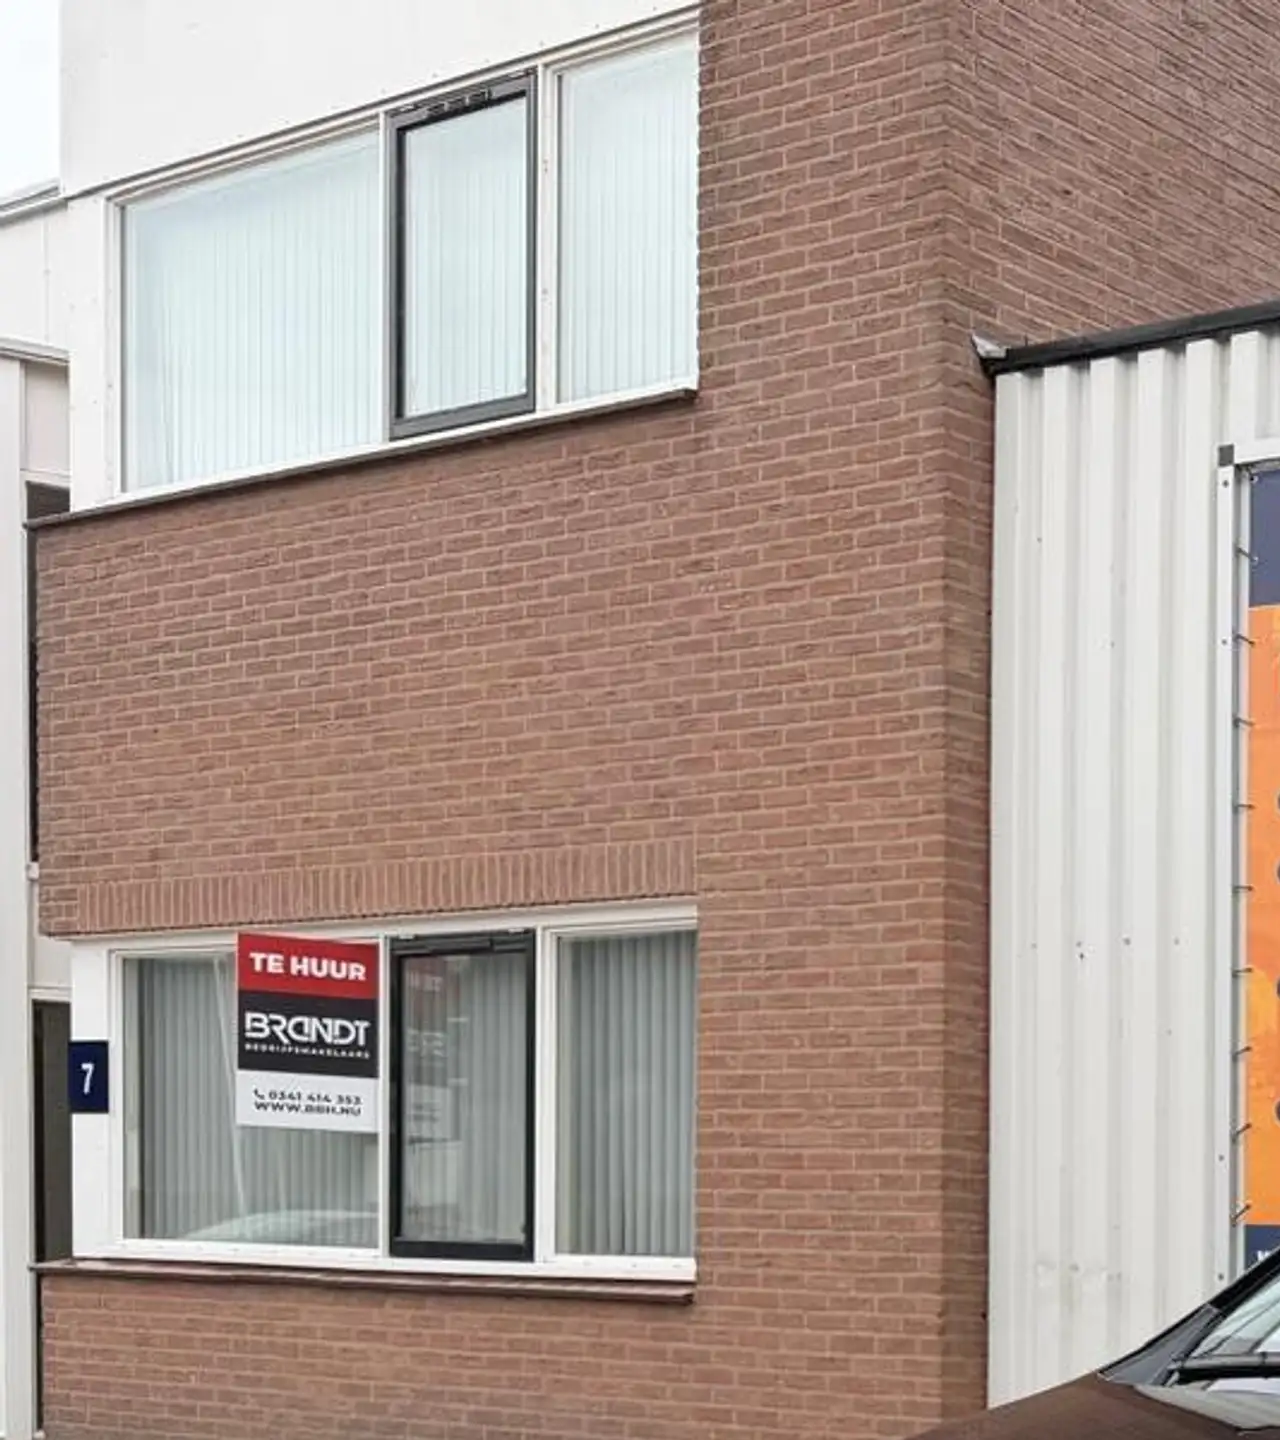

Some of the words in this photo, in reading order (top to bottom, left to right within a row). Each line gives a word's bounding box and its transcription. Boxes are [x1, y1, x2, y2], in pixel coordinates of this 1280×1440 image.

[249, 953, 284, 973] TE
[291, 956, 366, 981] HUUR
[244, 1012, 371, 1046] BRANDT
[81, 1062, 94, 1094] 7
